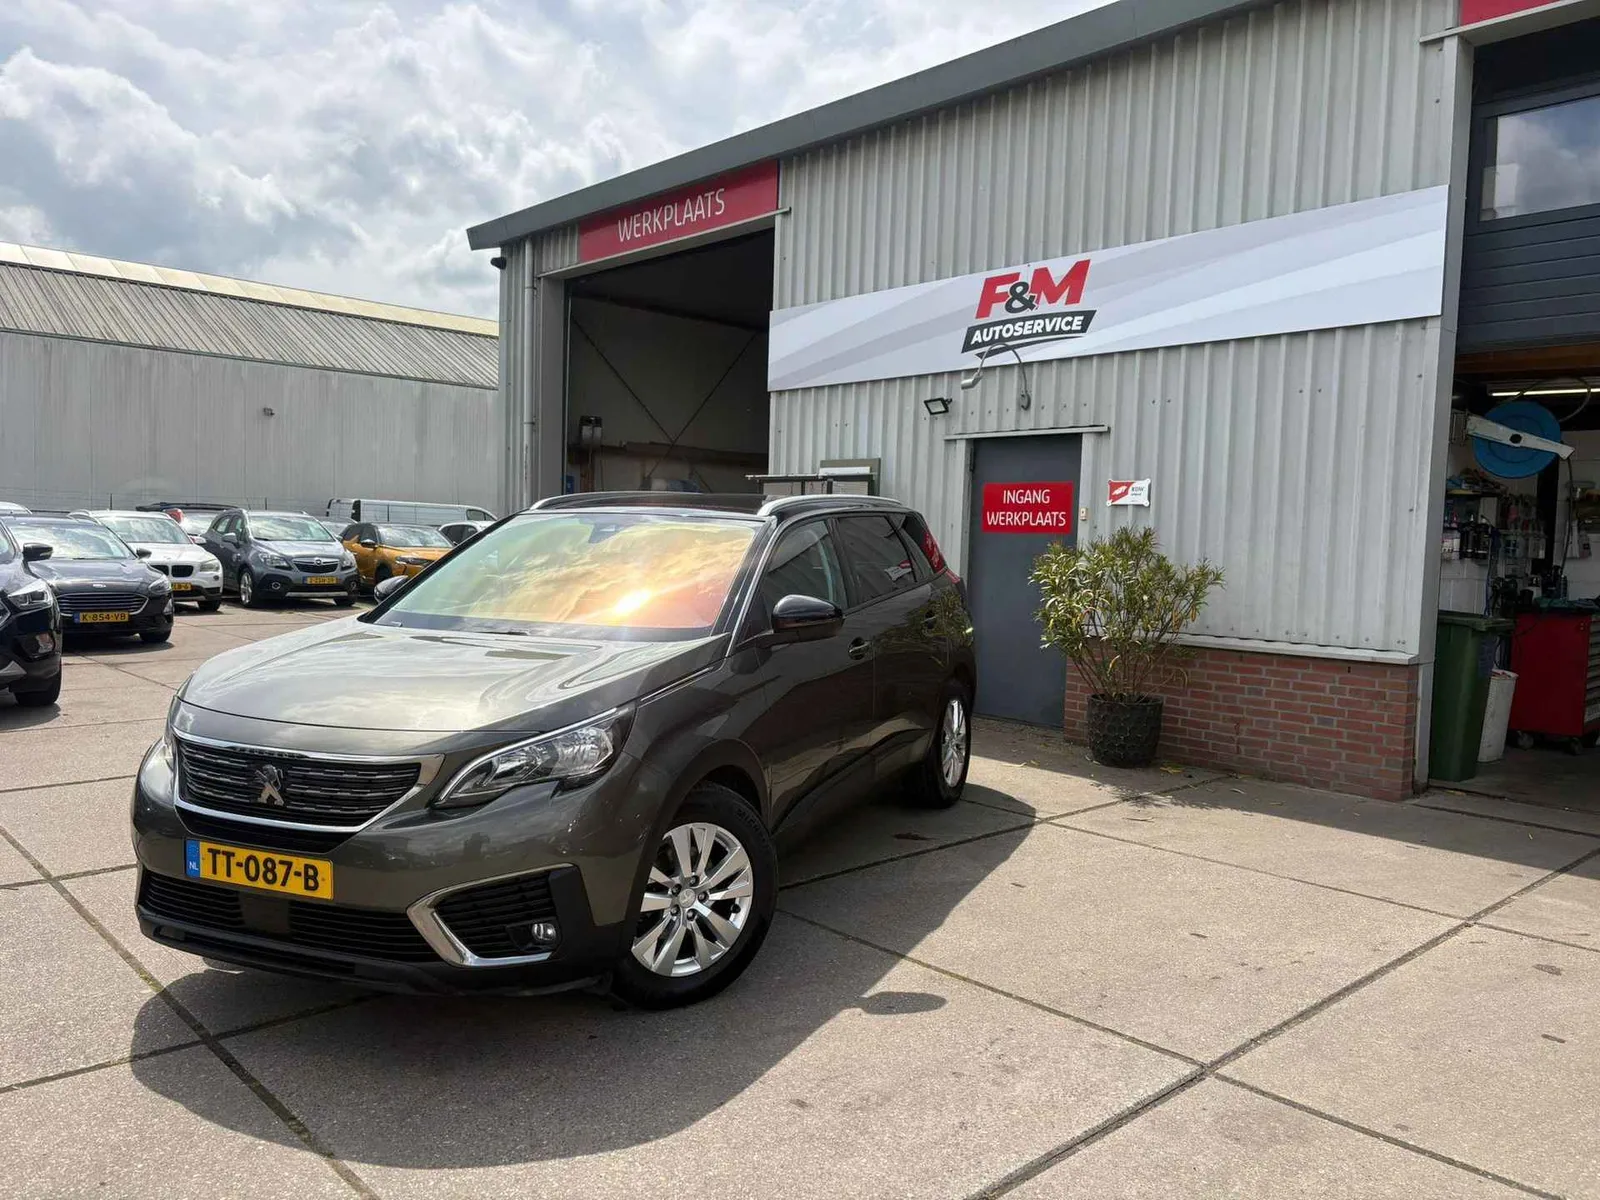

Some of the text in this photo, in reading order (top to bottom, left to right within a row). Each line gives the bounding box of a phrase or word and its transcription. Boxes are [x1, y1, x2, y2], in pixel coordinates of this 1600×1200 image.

[618, 188, 725, 242] WERKPLAATS
[975, 259, 1091, 319] F&M
[970, 315, 1085, 345] AUTOSERVICE
[1002, 489, 1050, 504] INGANG
[986, 511, 1066, 527] WERKPLAATS
[188, 847, 320, 891] NL TT-087-B
